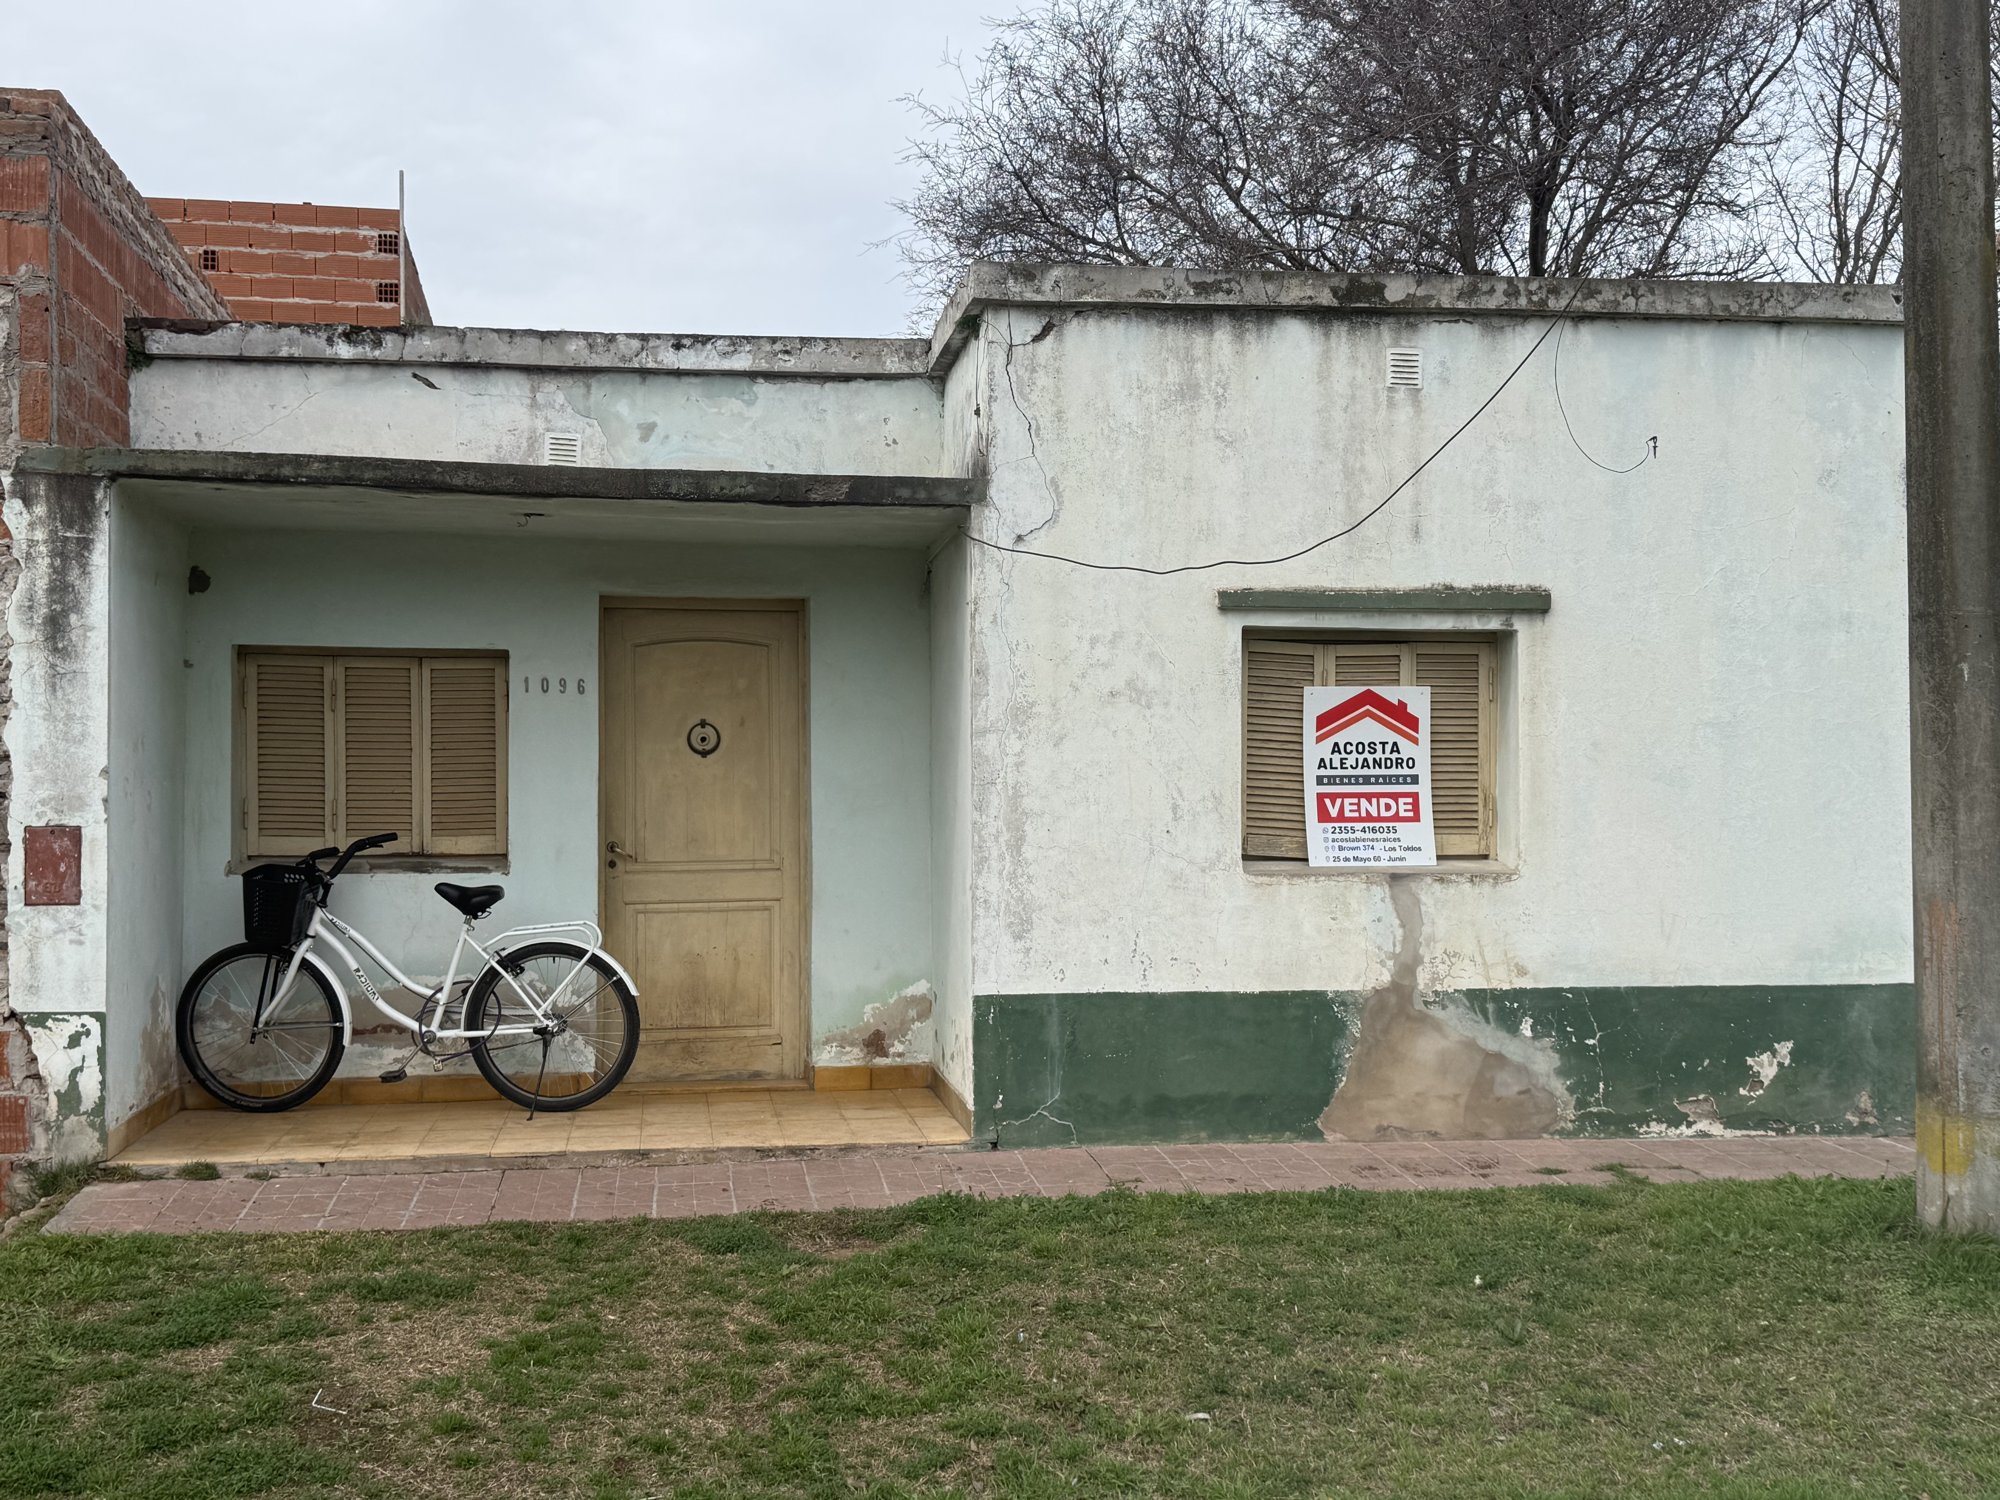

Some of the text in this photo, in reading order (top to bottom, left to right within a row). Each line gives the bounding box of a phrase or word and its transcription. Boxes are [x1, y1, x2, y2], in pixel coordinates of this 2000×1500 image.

[524, 676, 585, 695] 1096
[1330, 741, 1401, 755] ACOSTA
[1317, 757, 1416, 770] ALEJANDRO
[1324, 798, 1414, 817] VENDE
[1331, 826, 1398, 834] 2355-416035
[1342, 855, 1351, 863] de
[1352, 855, 1372, 864] Mayo
